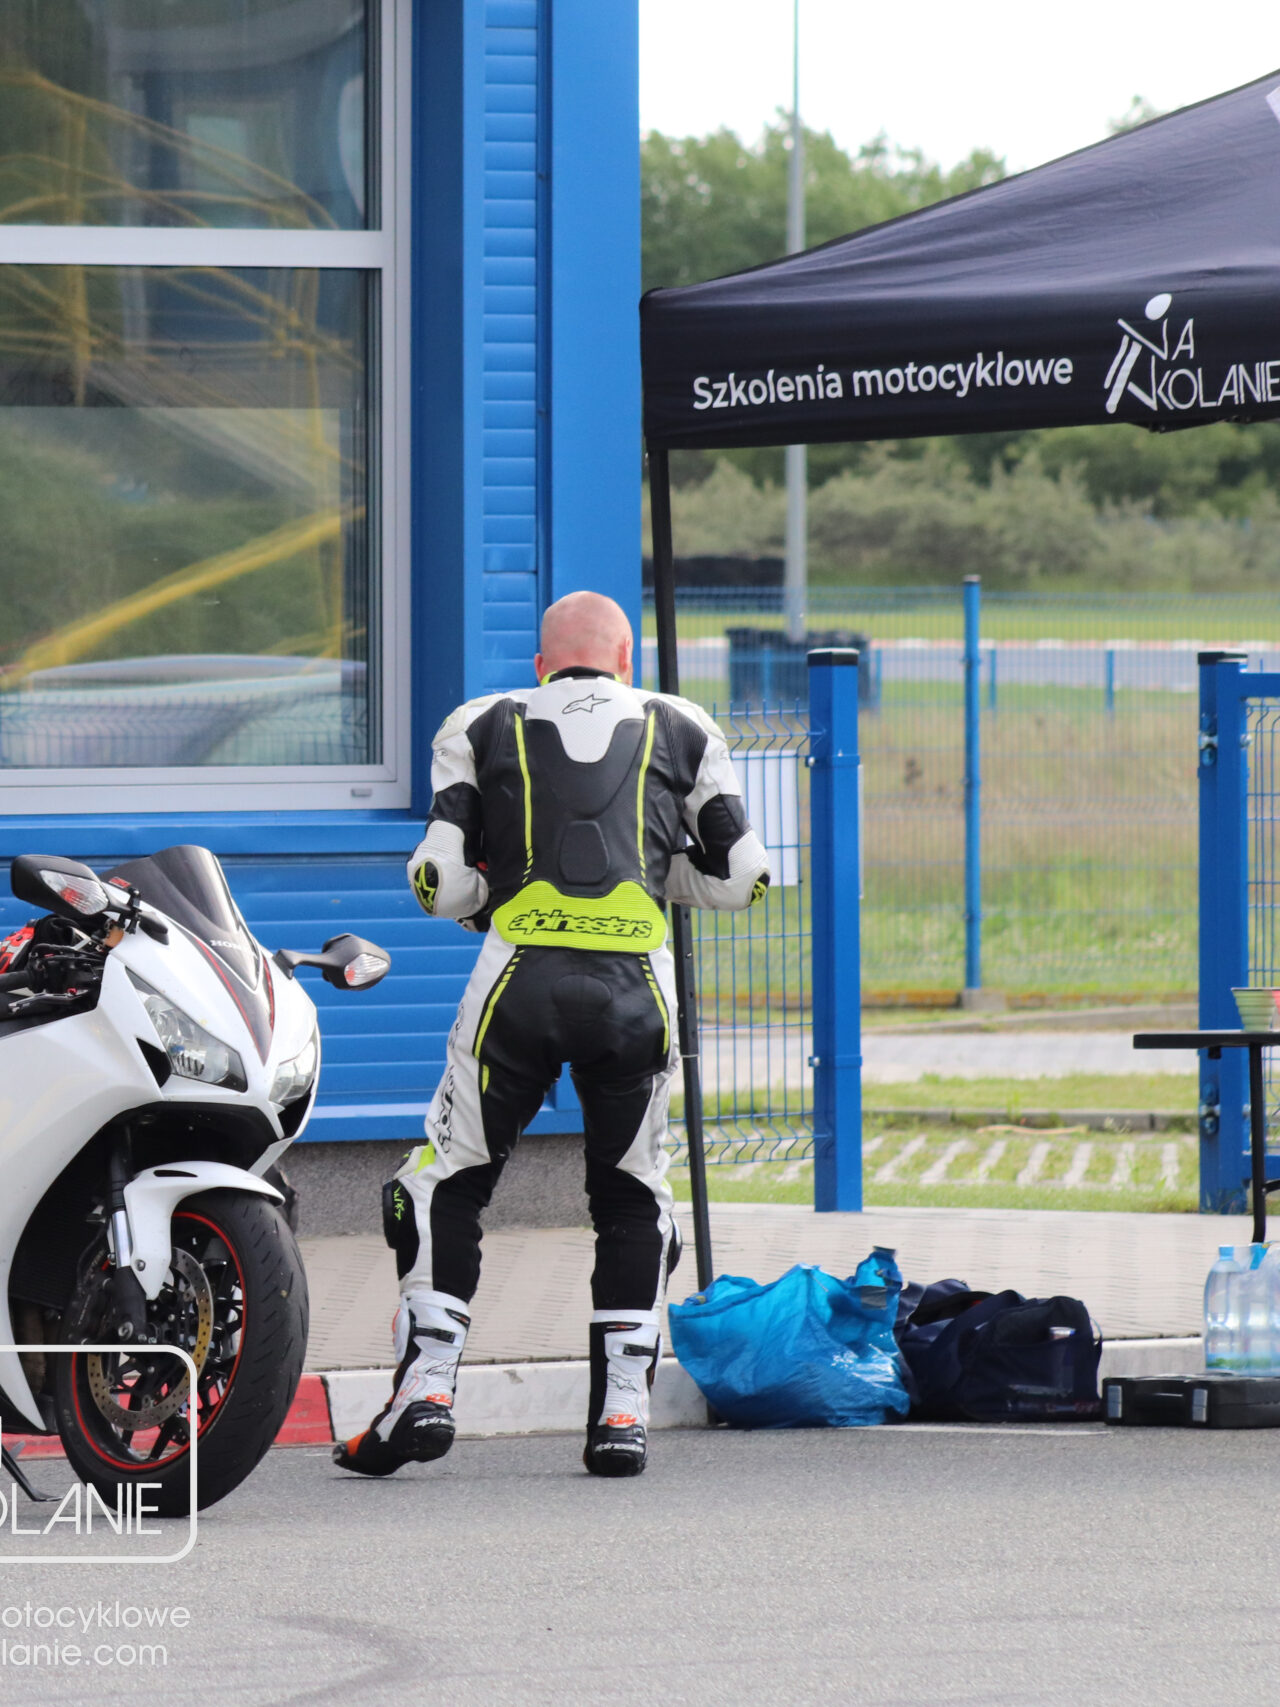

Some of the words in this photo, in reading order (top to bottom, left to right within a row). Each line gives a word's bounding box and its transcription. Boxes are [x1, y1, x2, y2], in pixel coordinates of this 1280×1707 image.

[1117, 318, 1194, 361] NA
[692, 365, 844, 411] Szkolenia
[853, 350, 1075, 403] motocyklowe
[1128, 355, 1280, 411] KOLANIE
[507, 908, 654, 939] alpinestars
